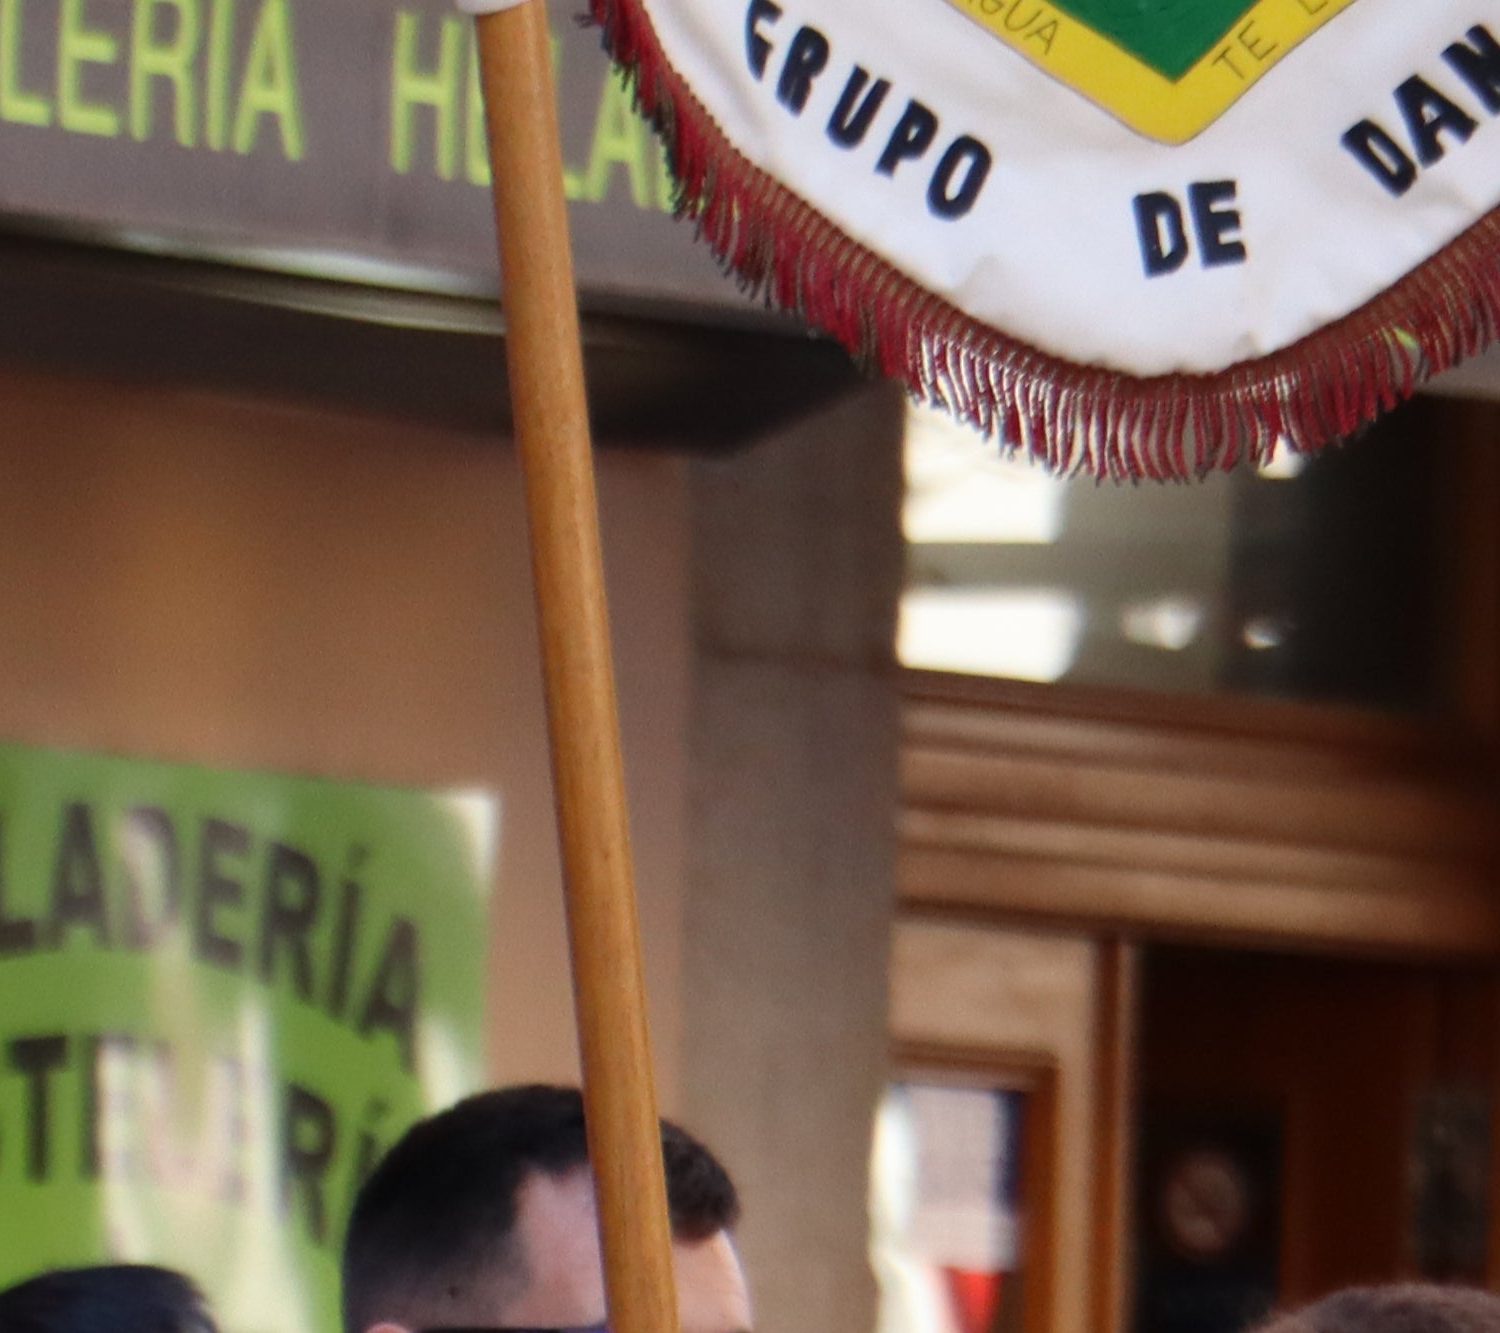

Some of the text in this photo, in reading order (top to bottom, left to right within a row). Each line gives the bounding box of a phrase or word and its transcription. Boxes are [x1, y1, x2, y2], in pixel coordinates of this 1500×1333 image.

[1212, 20, 1278, 80] TE
[745, 0, 993, 221] GRUPO
[1131, 179, 1247, 278] DE
